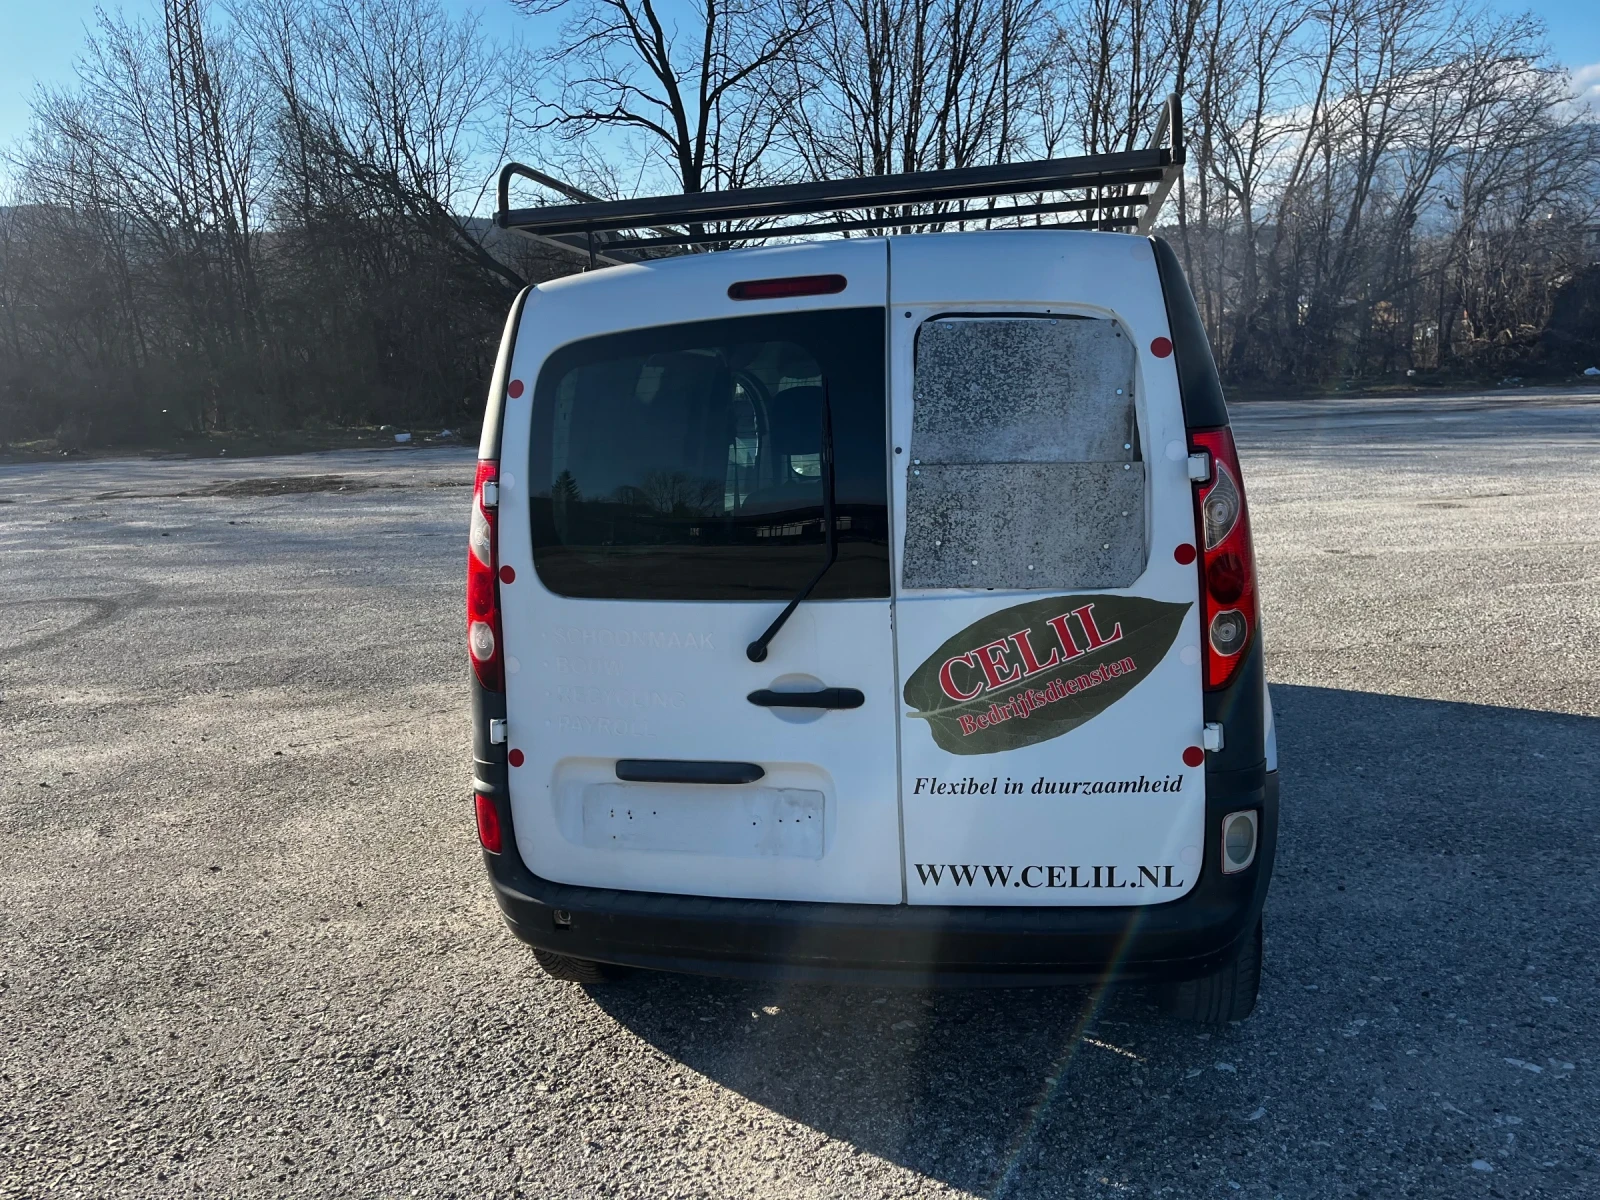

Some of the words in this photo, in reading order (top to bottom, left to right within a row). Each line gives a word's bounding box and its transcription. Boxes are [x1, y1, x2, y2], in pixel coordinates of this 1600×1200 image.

[554, 626, 715, 650] SCHOONMAAK
[938, 603, 1123, 701] CELIL
[555, 655, 625, 676] BOUW
[956, 656, 1137, 737] Bedrijfsdiensten
[557, 714, 657, 738] PAYROLL
[913, 777, 998, 795] Flexibel
[1004, 777, 1024, 795] in
[1031, 775, 1183, 796] duurzaamheid
[914, 863, 1184, 888] WWW.CELIL.NL
